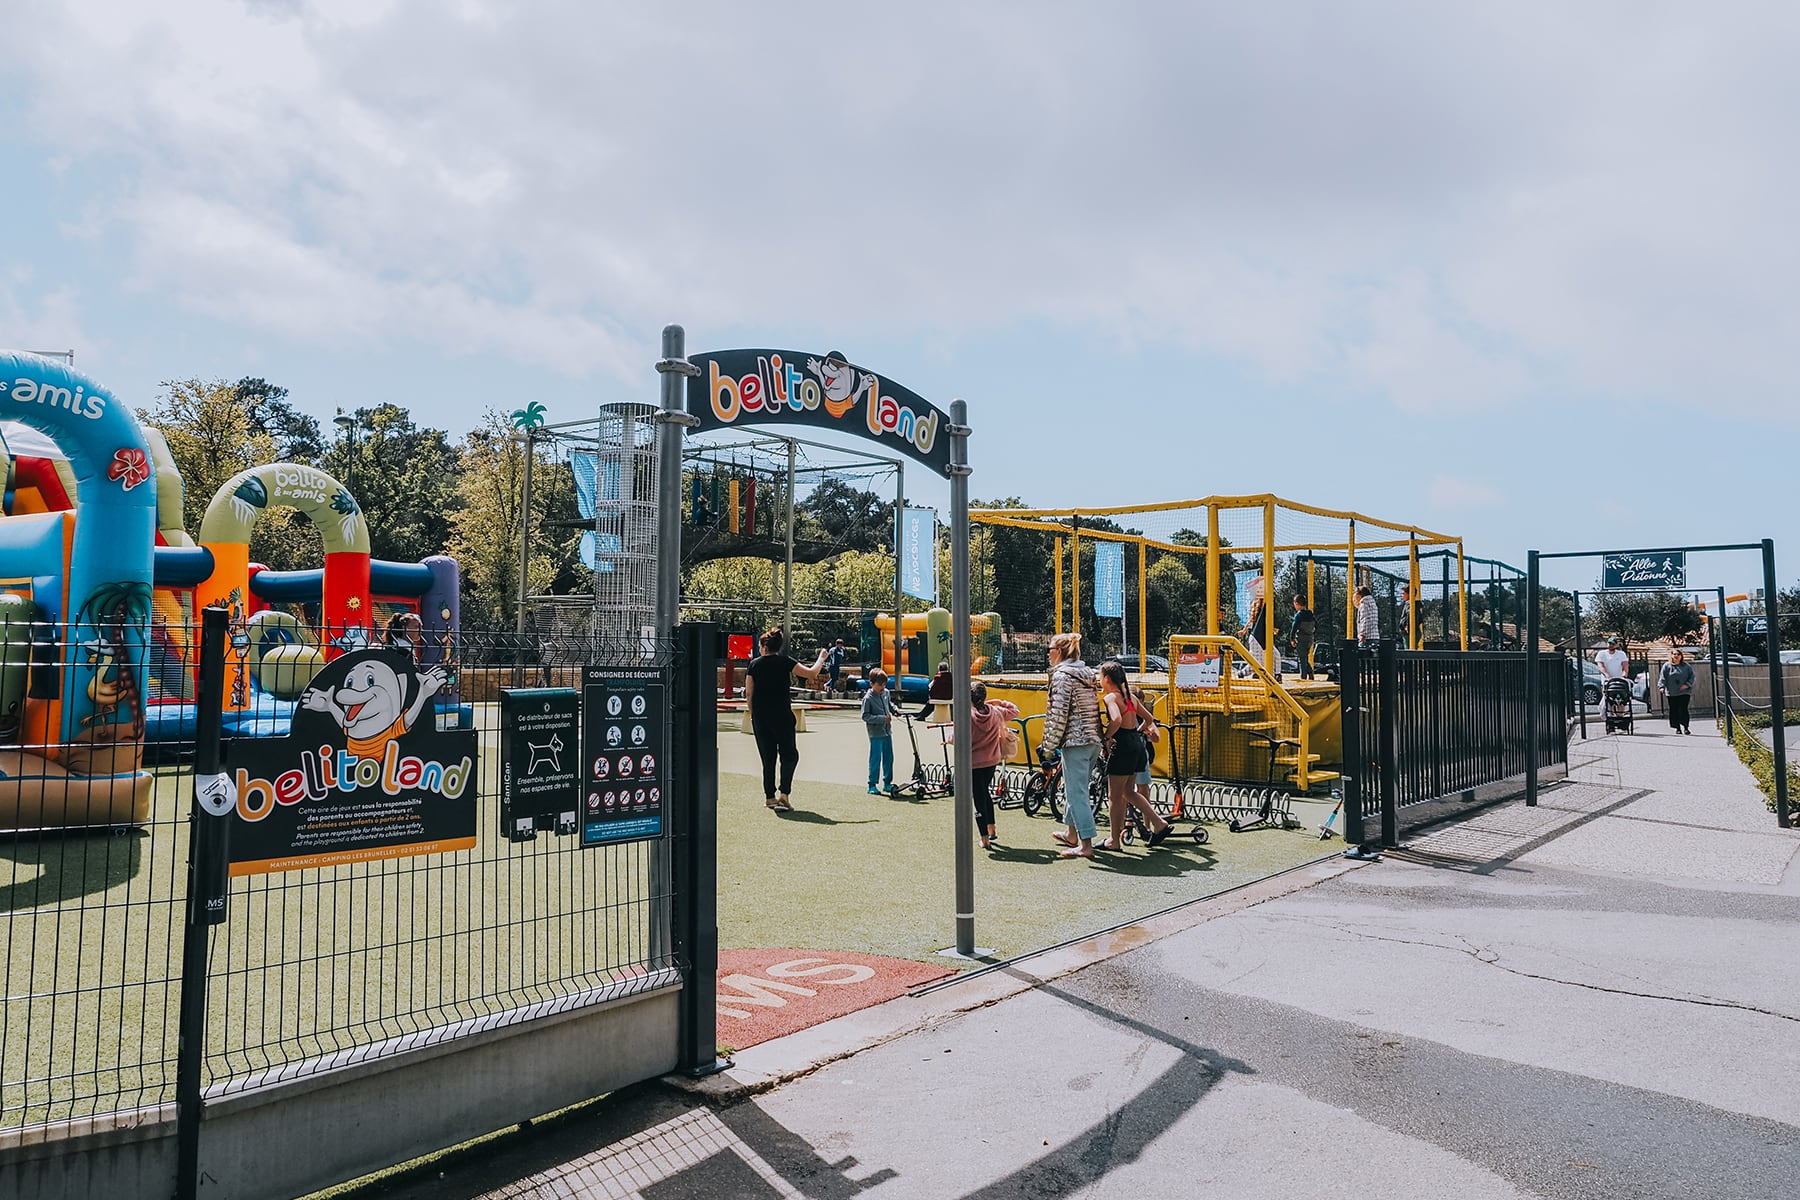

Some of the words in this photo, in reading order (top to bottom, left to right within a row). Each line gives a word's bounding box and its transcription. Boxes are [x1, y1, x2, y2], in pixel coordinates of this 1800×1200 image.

[11, 378, 106, 420] amis
[708, 353, 821, 423] belito
[866, 373, 939, 454] land
[274, 467, 327, 490] belito
[274, 486, 281, 497] &
[292, 488, 327, 503] amis
[589, 671, 625, 679] CONSIGNES
[625, 671, 633, 679] DE
[633, 670, 661, 679] SÉCURITÉ
[526, 713, 554, 722] distributeur
[554, 712, 561, 720] de
[519, 724, 527, 732] est
[531, 785, 554, 793] espaces
[298, 806, 317, 815] Cette
[317, 806, 329, 814] aire
[338, 805, 351, 814] jeux
[382, 798, 422, 809] responsabilité
[306, 821, 338, 830] destinées
[350, 818, 374, 826] enfants
[380, 816, 396, 824] partir
[307, 814, 319, 822] des
[319, 812, 344, 822] parents
[354, 808, 406, 818] accompagnateurs
[290, 840, 303, 848] and
[313, 836, 345, 847] playground
[350, 833, 378, 842] dedicated
[385, 830, 406, 838] children
[406, 828, 419, 836] from
[296, 832, 318, 840] Parents
[330, 828, 362, 838] responsible
[362, 826, 370, 834] for
[384, 824, 406, 832] children
[270, 858, 318, 868] MAINTENANCE
[352, 852, 363, 860] LES
[364, 849, 396, 858] BRUNELLES
[208, 898, 224, 907] MS
